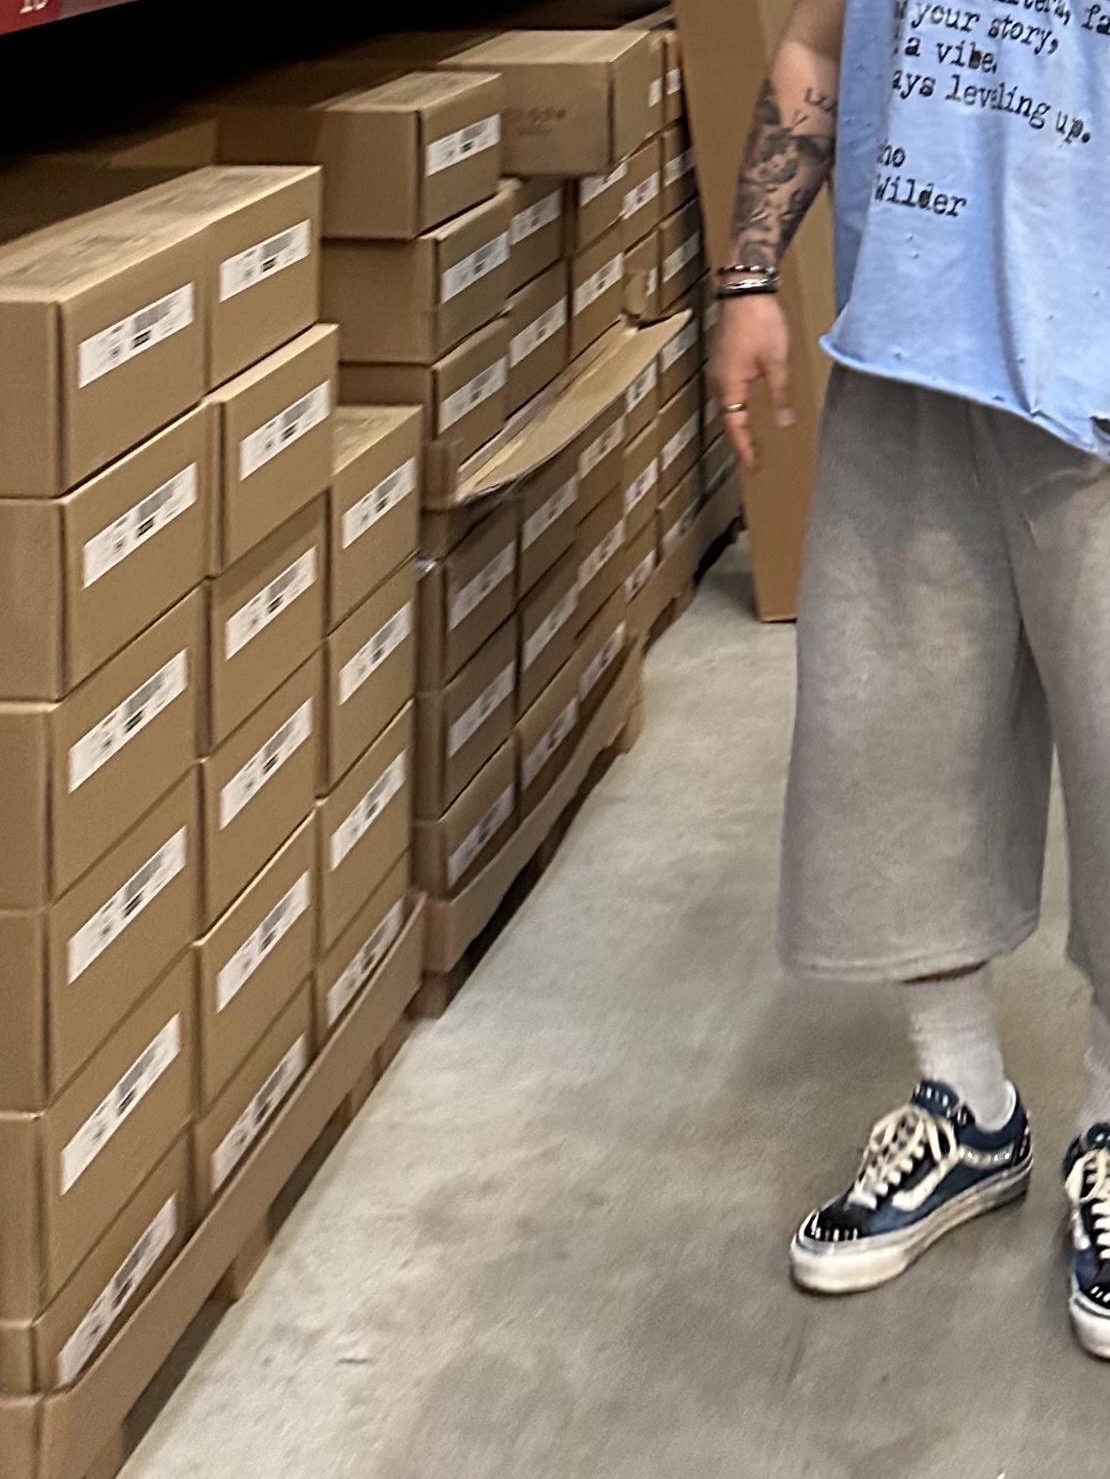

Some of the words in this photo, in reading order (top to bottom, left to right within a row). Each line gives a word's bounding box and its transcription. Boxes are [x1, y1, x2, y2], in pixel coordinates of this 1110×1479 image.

[911, 2, 981, 33] your
[987, 14, 1060, 55] story,
[904, 36, 921, 57] a
[1055, 110, 1091, 144] up.
